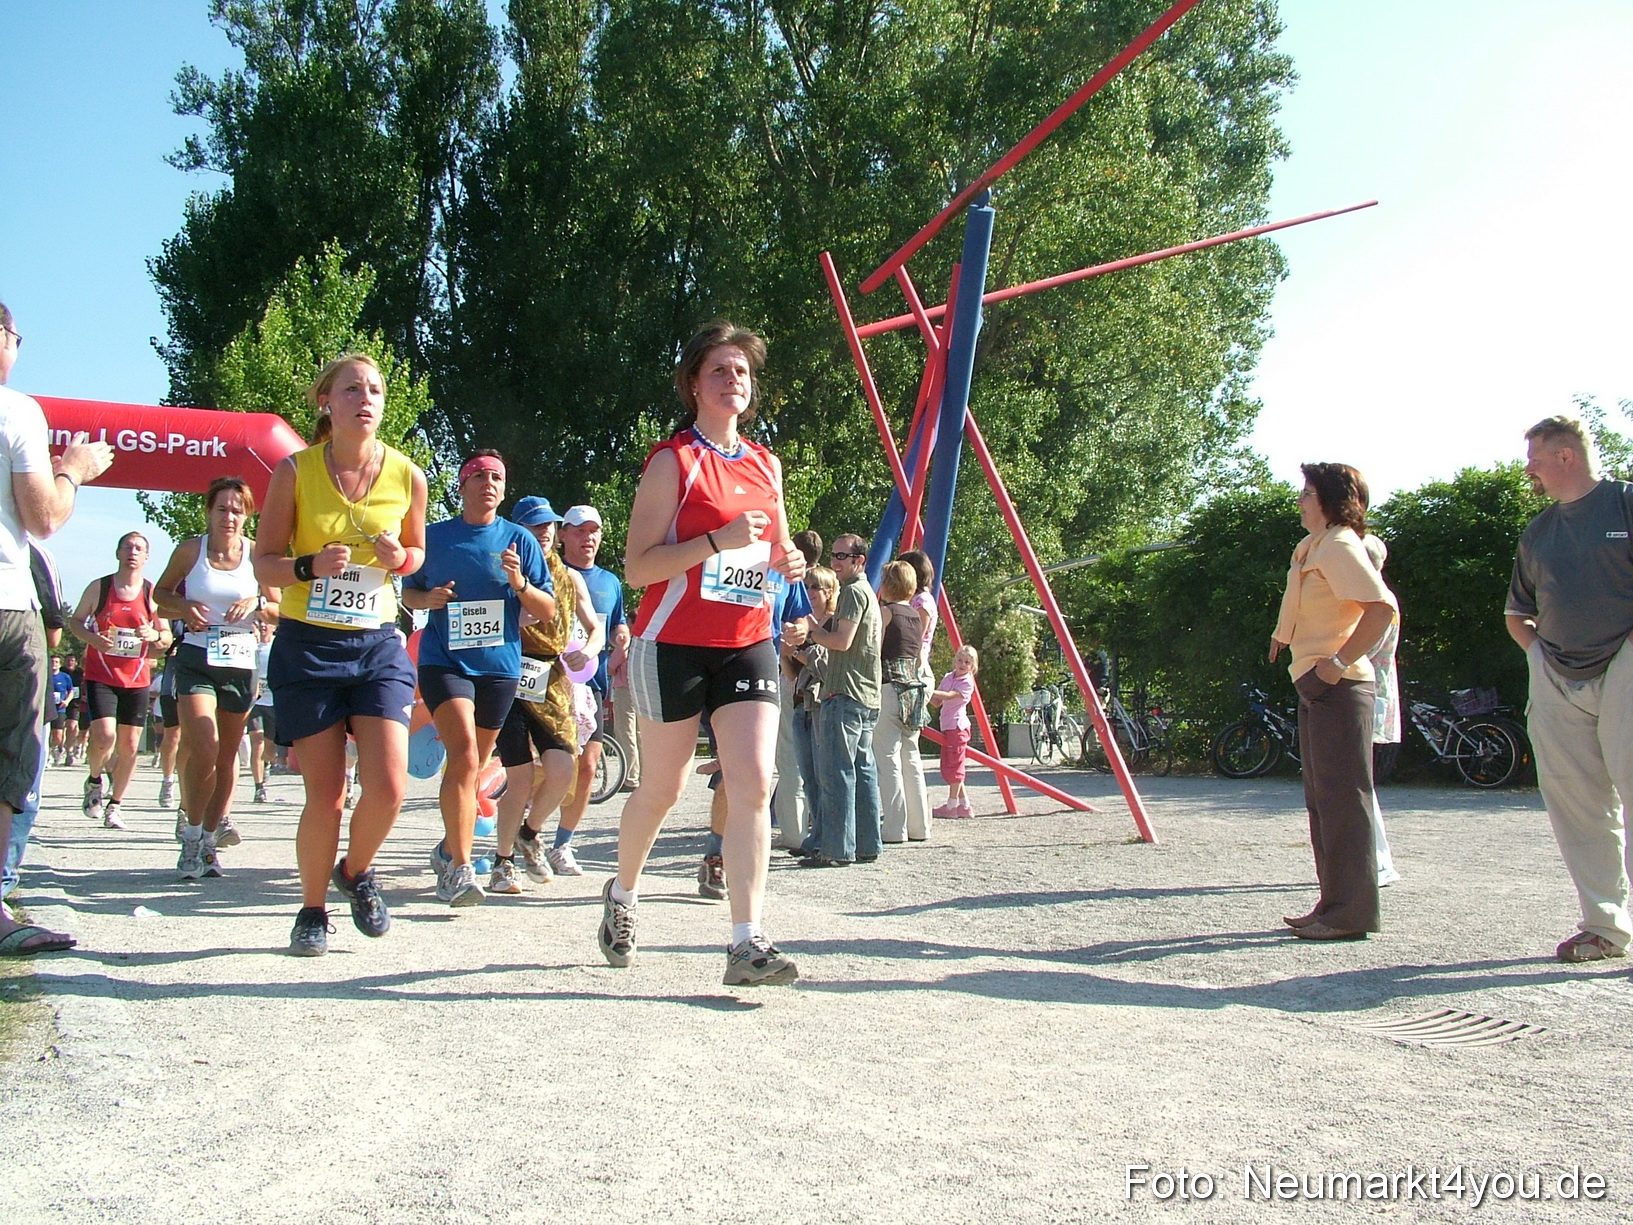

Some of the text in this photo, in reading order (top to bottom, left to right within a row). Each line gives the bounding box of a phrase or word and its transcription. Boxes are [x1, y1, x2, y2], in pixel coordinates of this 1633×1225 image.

[100, 427, 227, 457] LGS-Park
[723, 566, 764, 590] 2032
[315, 583, 323, 593] B
[329, 589, 379, 612] 2381
[462, 606, 487, 616] Gisela
[451, 620, 459, 629] D
[464, 620, 501, 636] 3354
[577, 628, 588, 640] 3
[519, 675, 537, 690] 50
[735, 678, 778, 694] S 12
